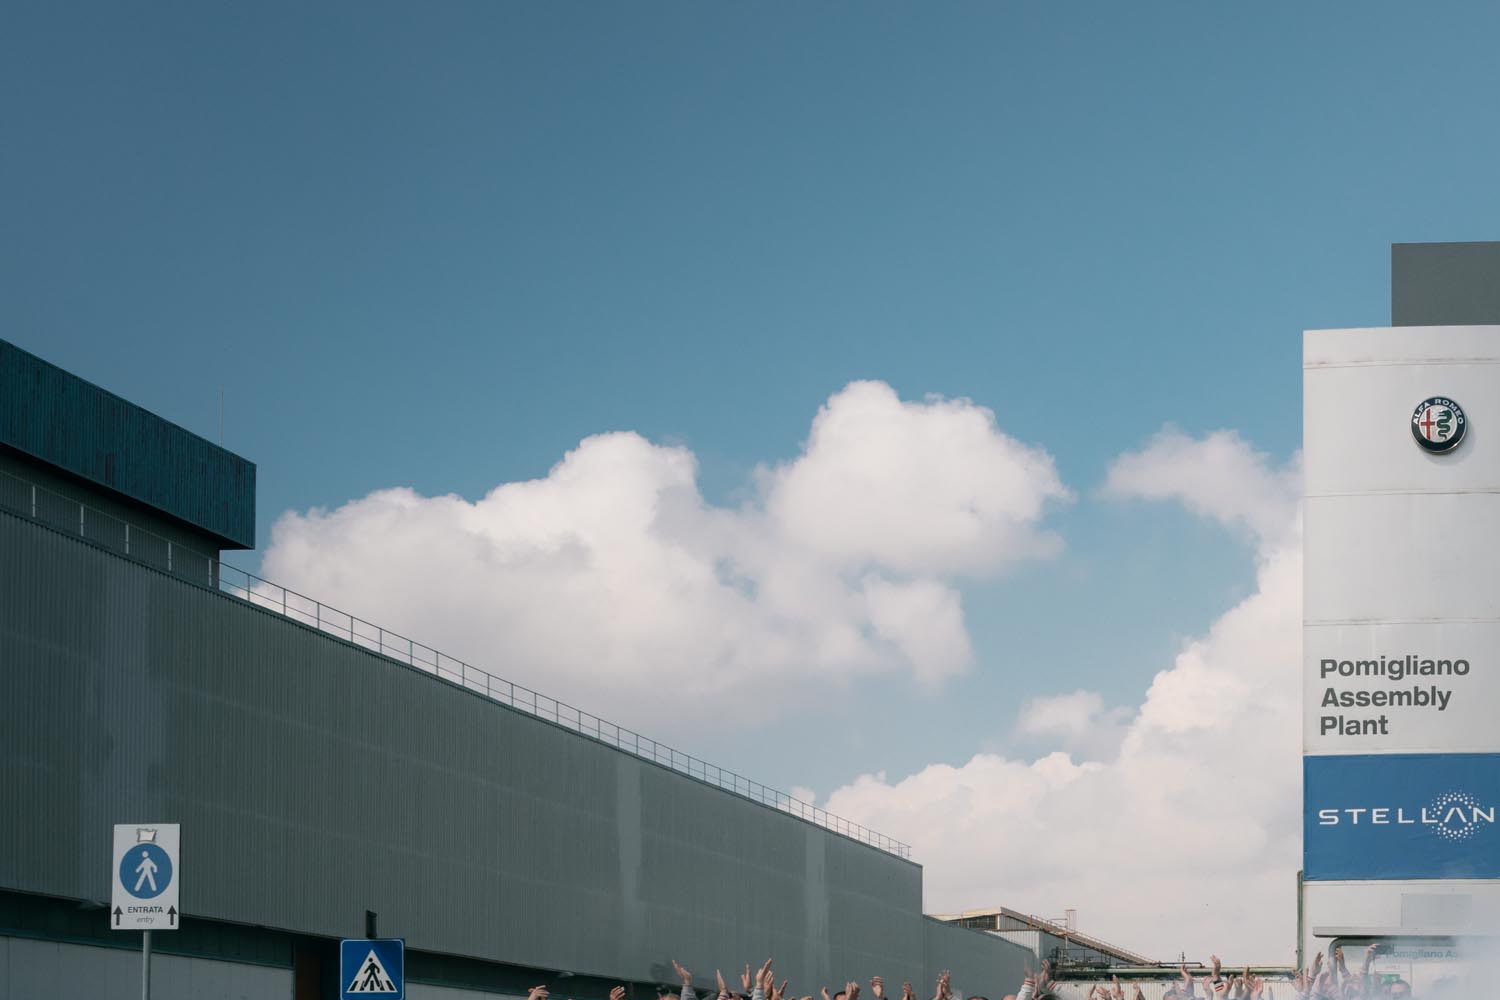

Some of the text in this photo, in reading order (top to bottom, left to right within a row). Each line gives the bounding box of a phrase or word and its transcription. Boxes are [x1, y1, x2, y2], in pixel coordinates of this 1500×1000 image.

[1413, 399, 1463, 424] ALFA ROMEO
[1320, 656, 1470, 681] Pomigliano
[1321, 686, 1452, 711] Assembly
[1320, 715, 1389, 736] Plant
